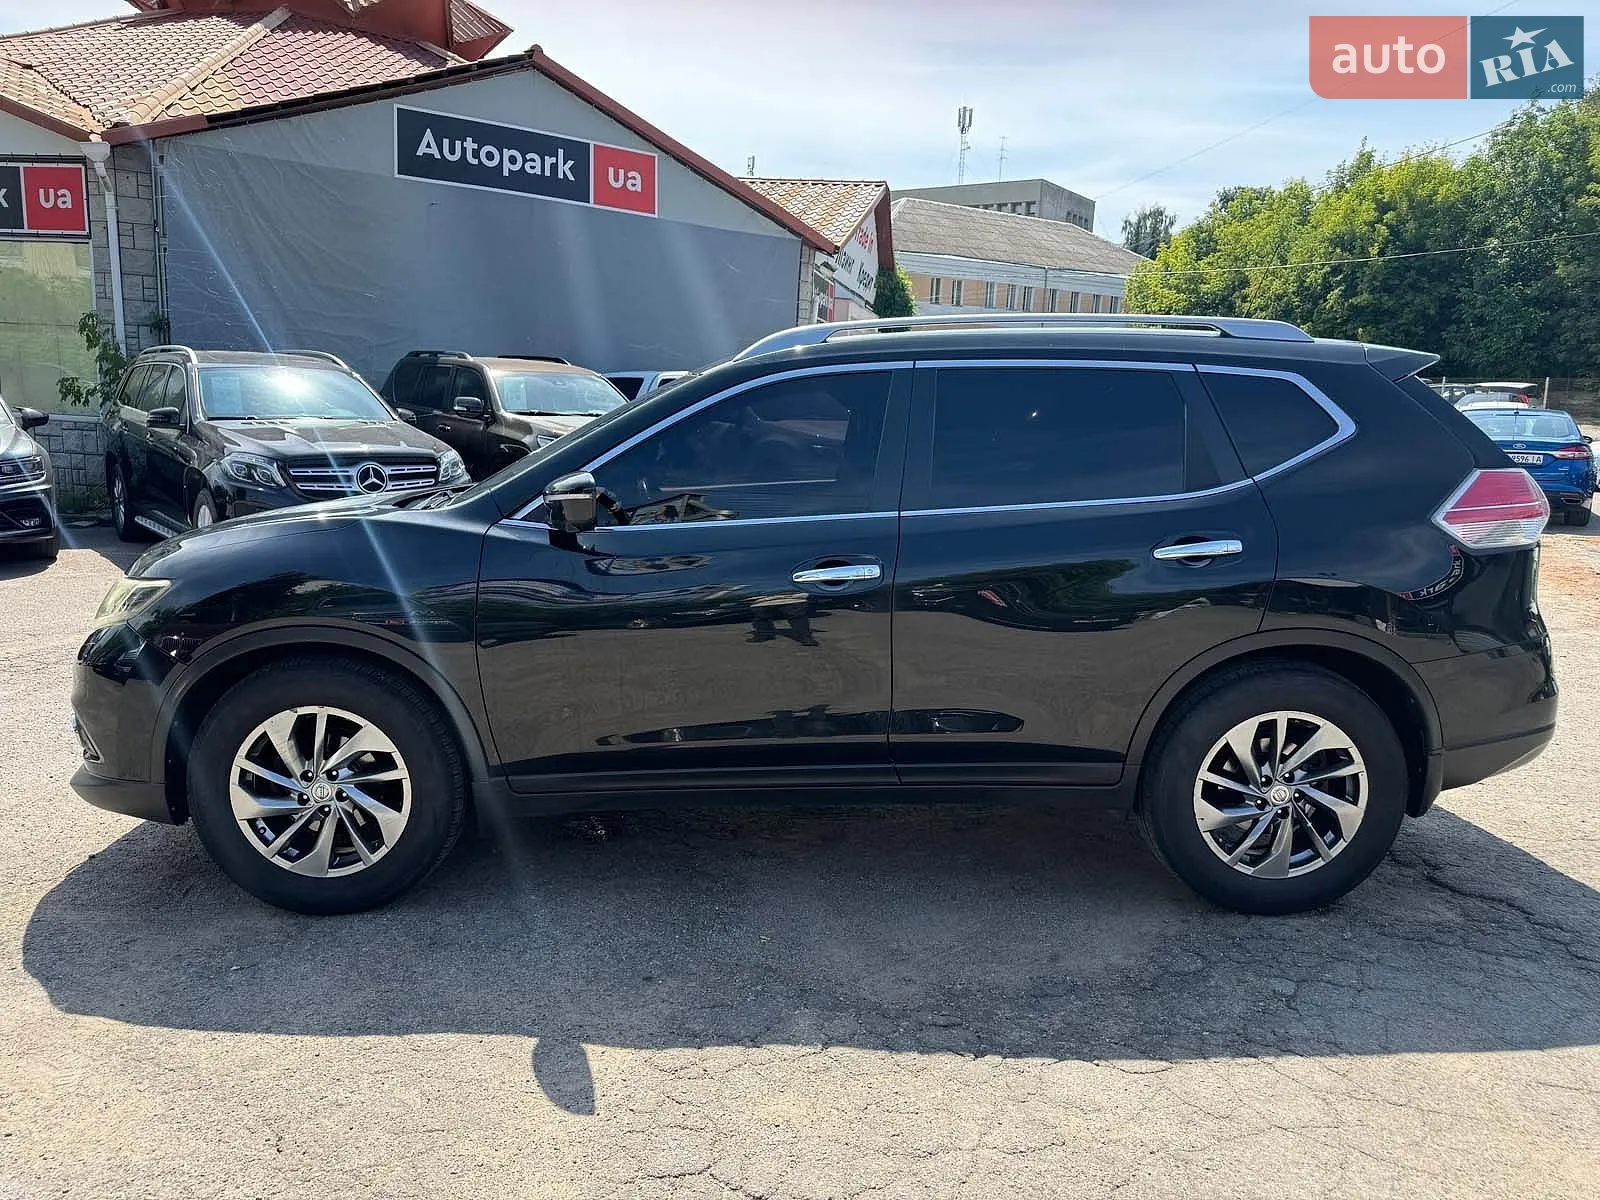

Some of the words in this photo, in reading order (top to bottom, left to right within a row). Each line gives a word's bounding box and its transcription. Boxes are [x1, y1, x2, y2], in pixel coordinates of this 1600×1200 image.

[416, 128, 576, 181] Autopark
[608, 167, 642, 192] ua
[39, 188, 72, 208] ua
